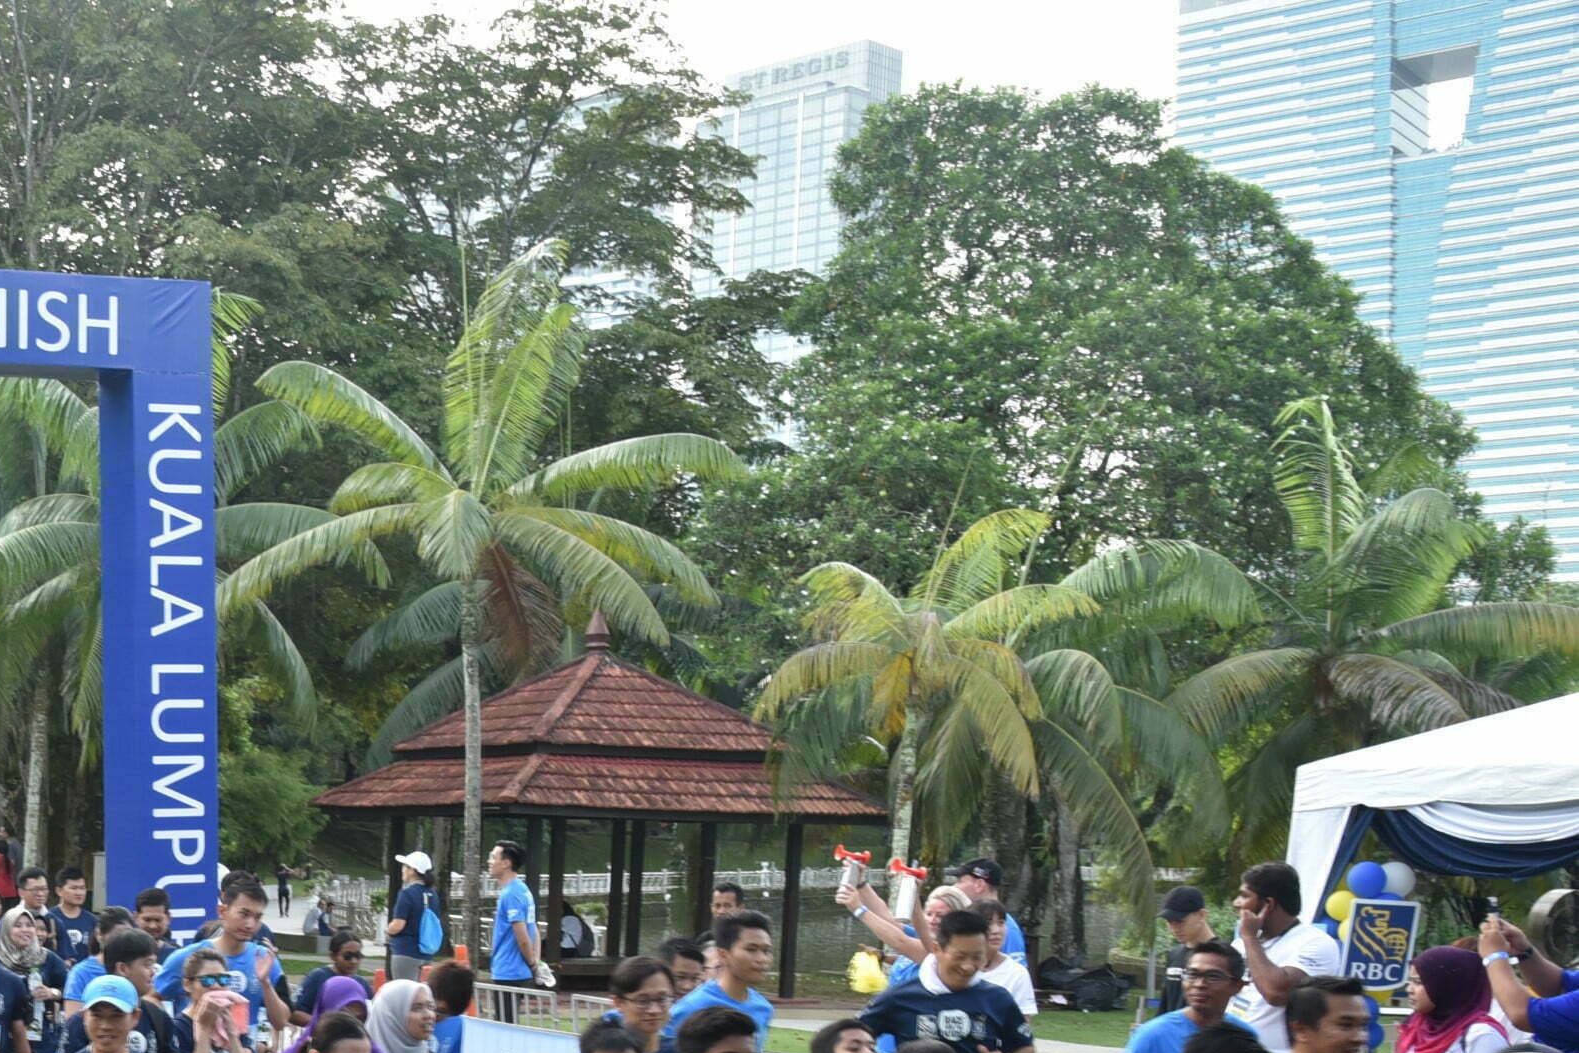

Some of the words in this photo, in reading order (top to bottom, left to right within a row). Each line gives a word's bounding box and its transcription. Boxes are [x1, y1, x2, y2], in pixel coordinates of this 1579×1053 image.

[771, 51, 850, 85] REGIS
[147, 403, 205, 638] KUALA
[151, 663, 206, 944] LUMPU
[1349, 961, 1401, 982] RBC
